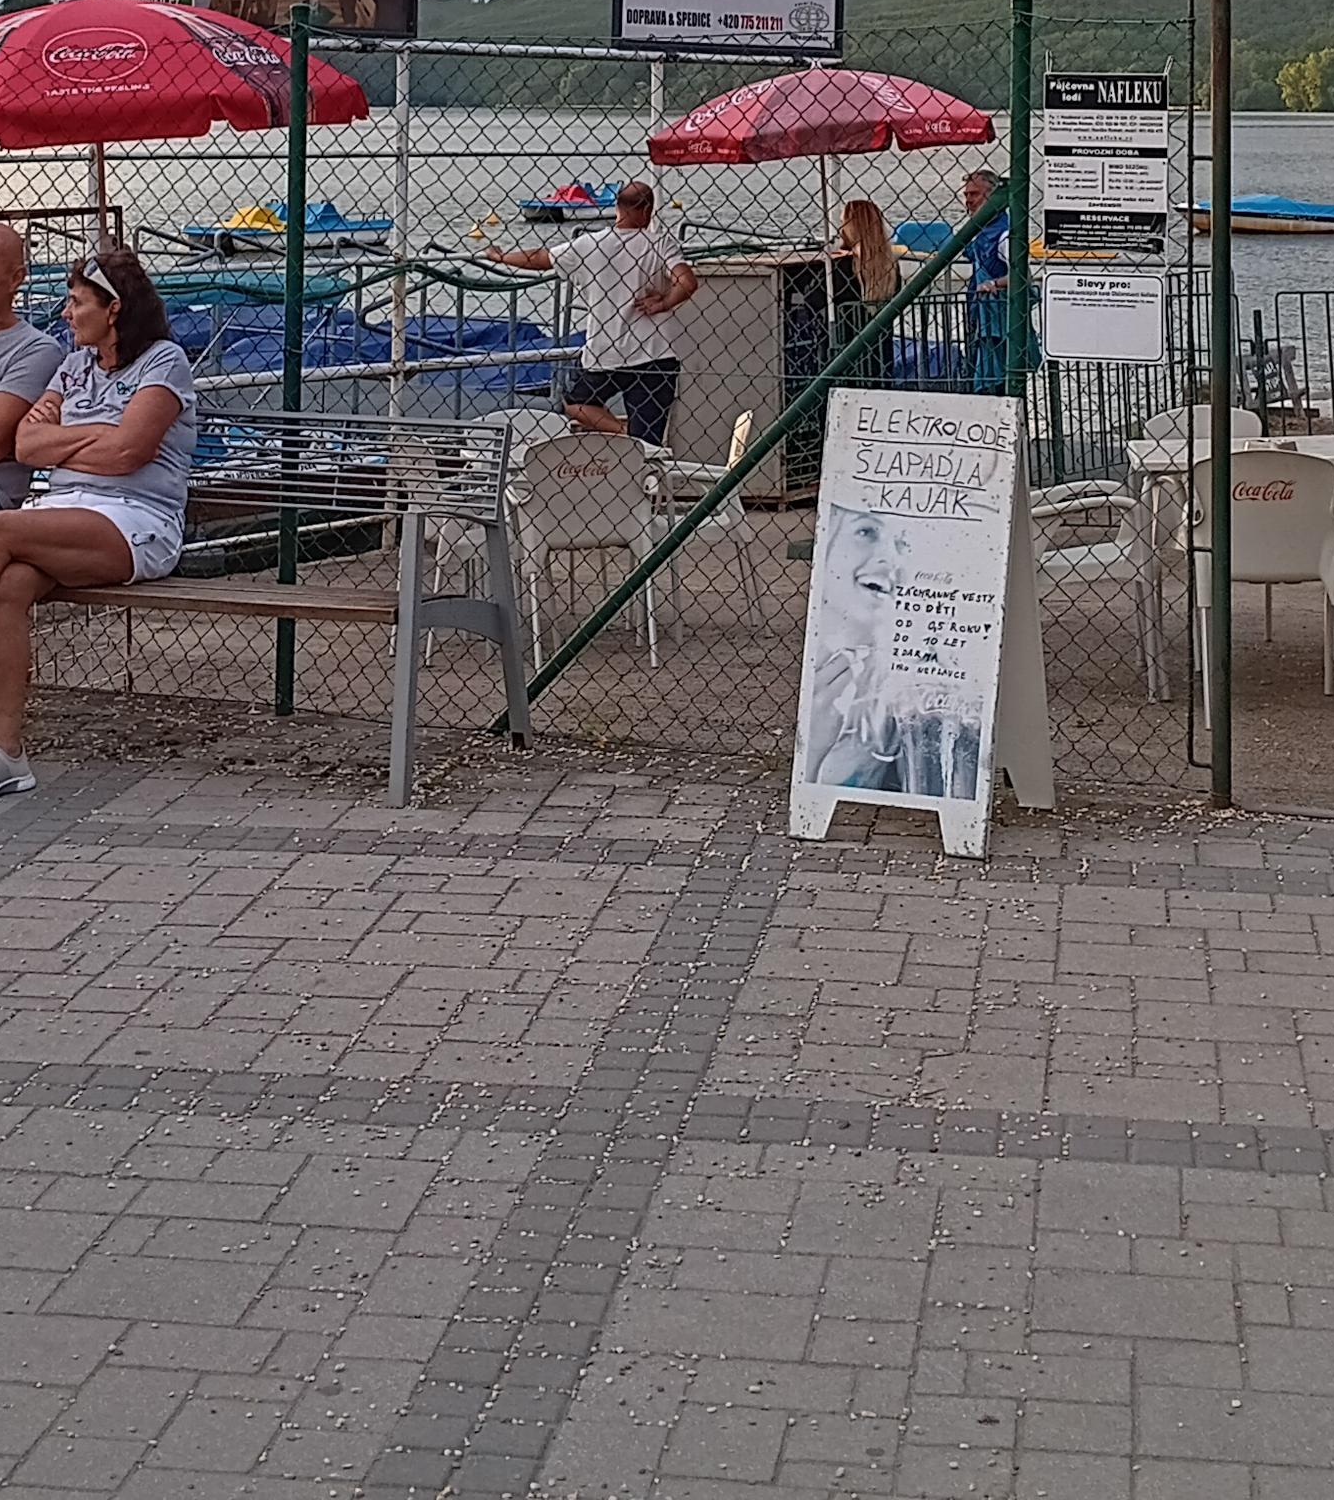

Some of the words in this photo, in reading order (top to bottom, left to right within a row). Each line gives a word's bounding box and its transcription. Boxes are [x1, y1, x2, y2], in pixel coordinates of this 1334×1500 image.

[626, 8, 667, 26] DOPRAVA
[668, 12, 675, 26] &
[676, 11, 711, 28] SPEDICE
[718, 13, 739, 29] +420
[740, 14, 754, 30] 775
[755, 16, 768, 31] 211
[770, 16, 783, 31] 211
[1097, 80, 1162, 105] NAFLEKU
[1076, 279, 1106, 290] Slevy
[1109, 281, 1131, 290] pro:
[856, 407, 1011, 449] ELEKTROLODĚ
[1232, 479, 1296, 501] Coca-Cola
[879, 483, 970, 517] KAJAK
[895, 600, 921, 612] PRO
[962, 592, 996, 604] VESTY
[895, 619, 913, 628] OD
[893, 633, 909, 643] DO
[923, 636, 939, 646] 10
[943, 638, 967, 648] LET
